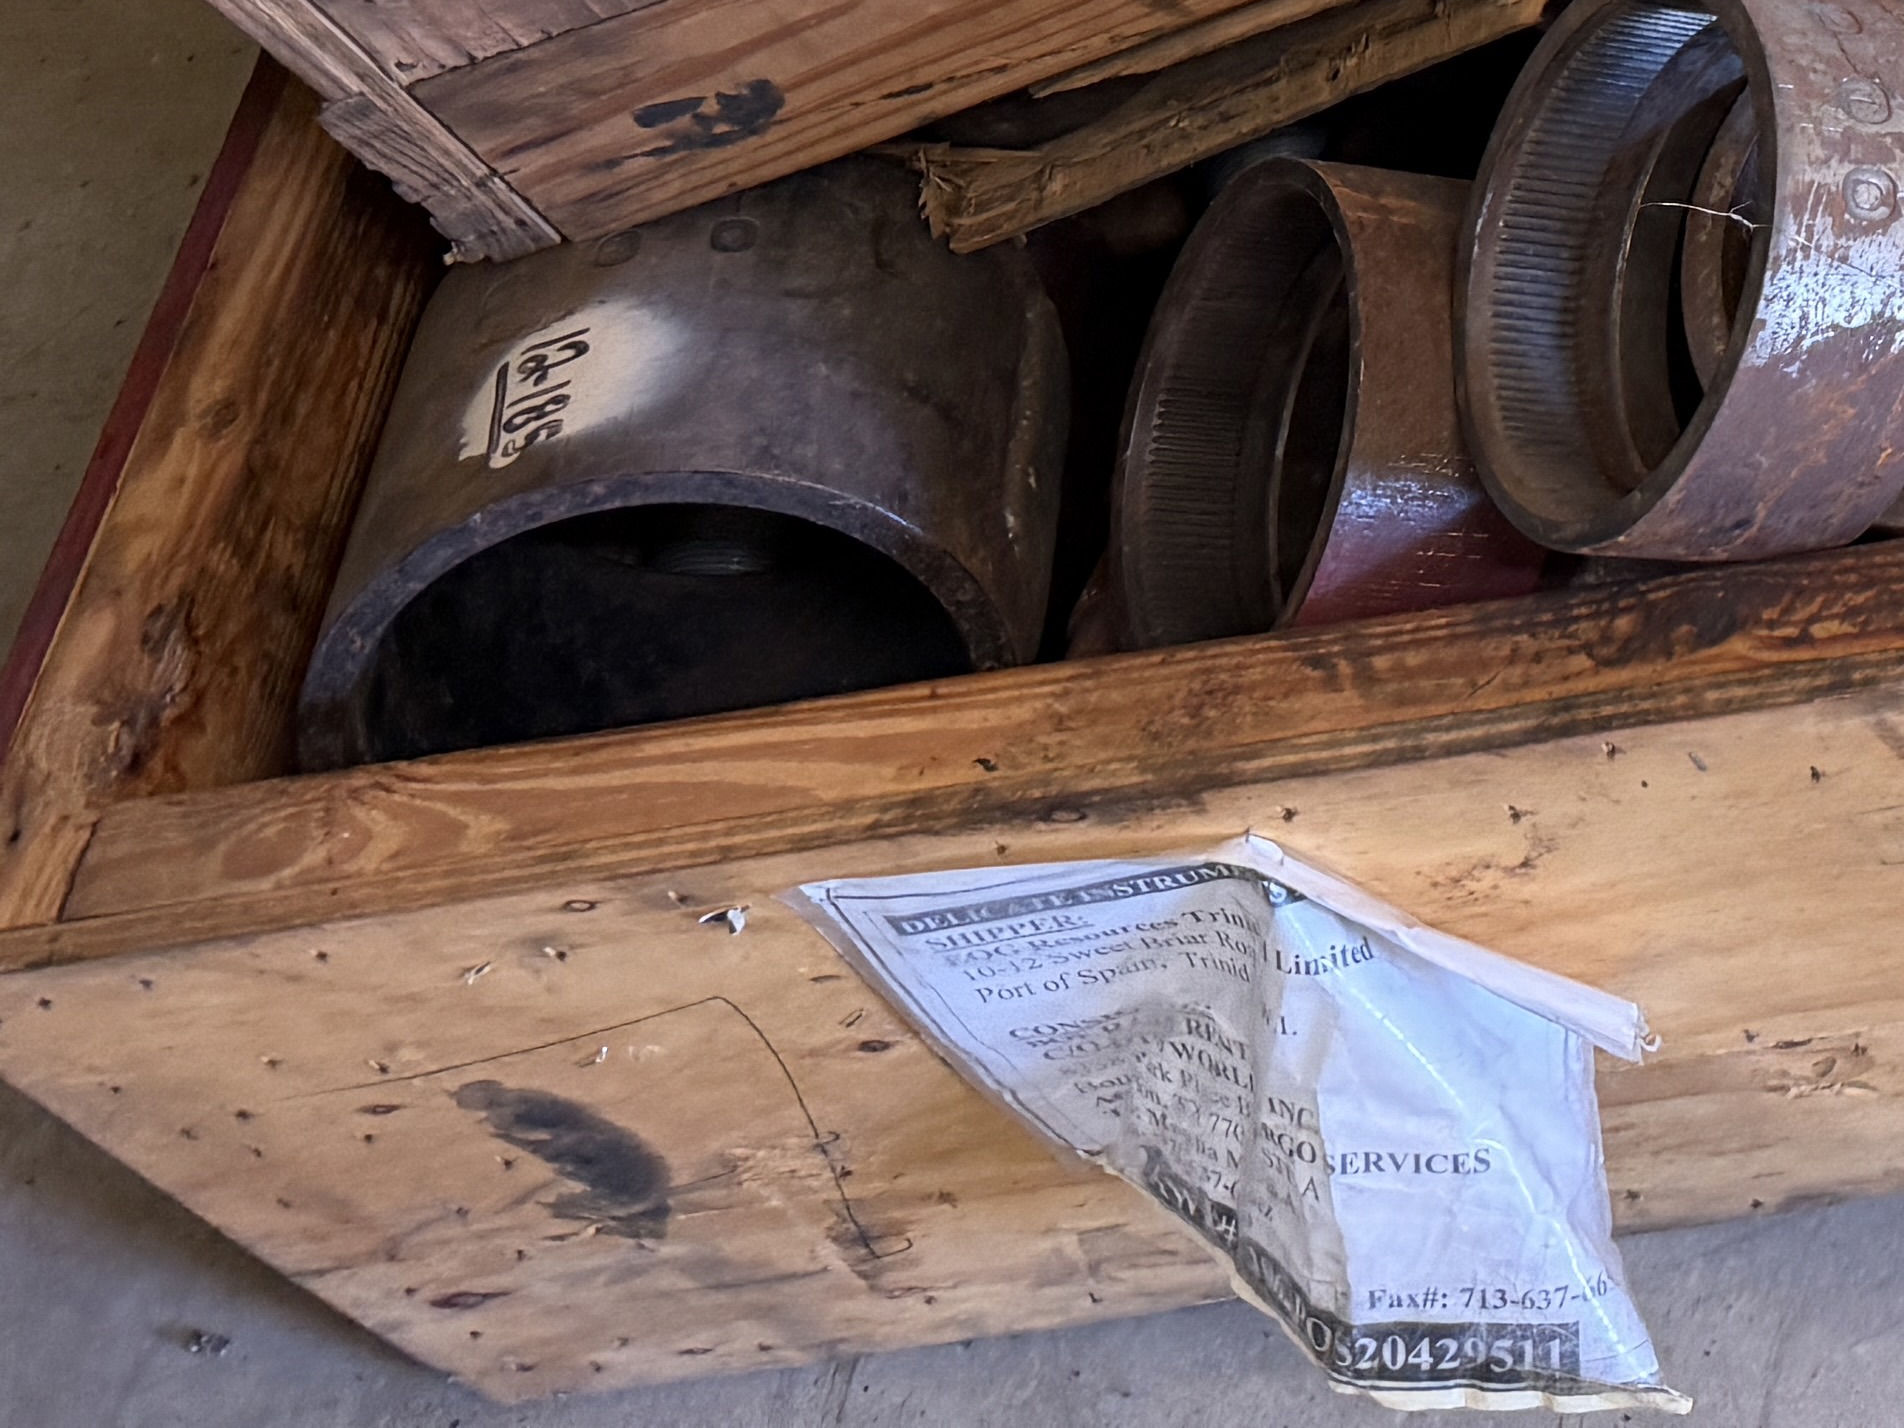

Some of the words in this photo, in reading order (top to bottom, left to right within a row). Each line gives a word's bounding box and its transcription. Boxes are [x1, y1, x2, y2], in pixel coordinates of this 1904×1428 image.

[924, 913, 1090, 949] SHIPPER:
[1275, 936, 1374, 976] Limited
[974, 981, 1037, 1004] Port
[1043, 971, 1071, 992] of
[1326, 1147, 1493, 1177] SERVICES
[1368, 1285, 1449, 1312] Fax#:
